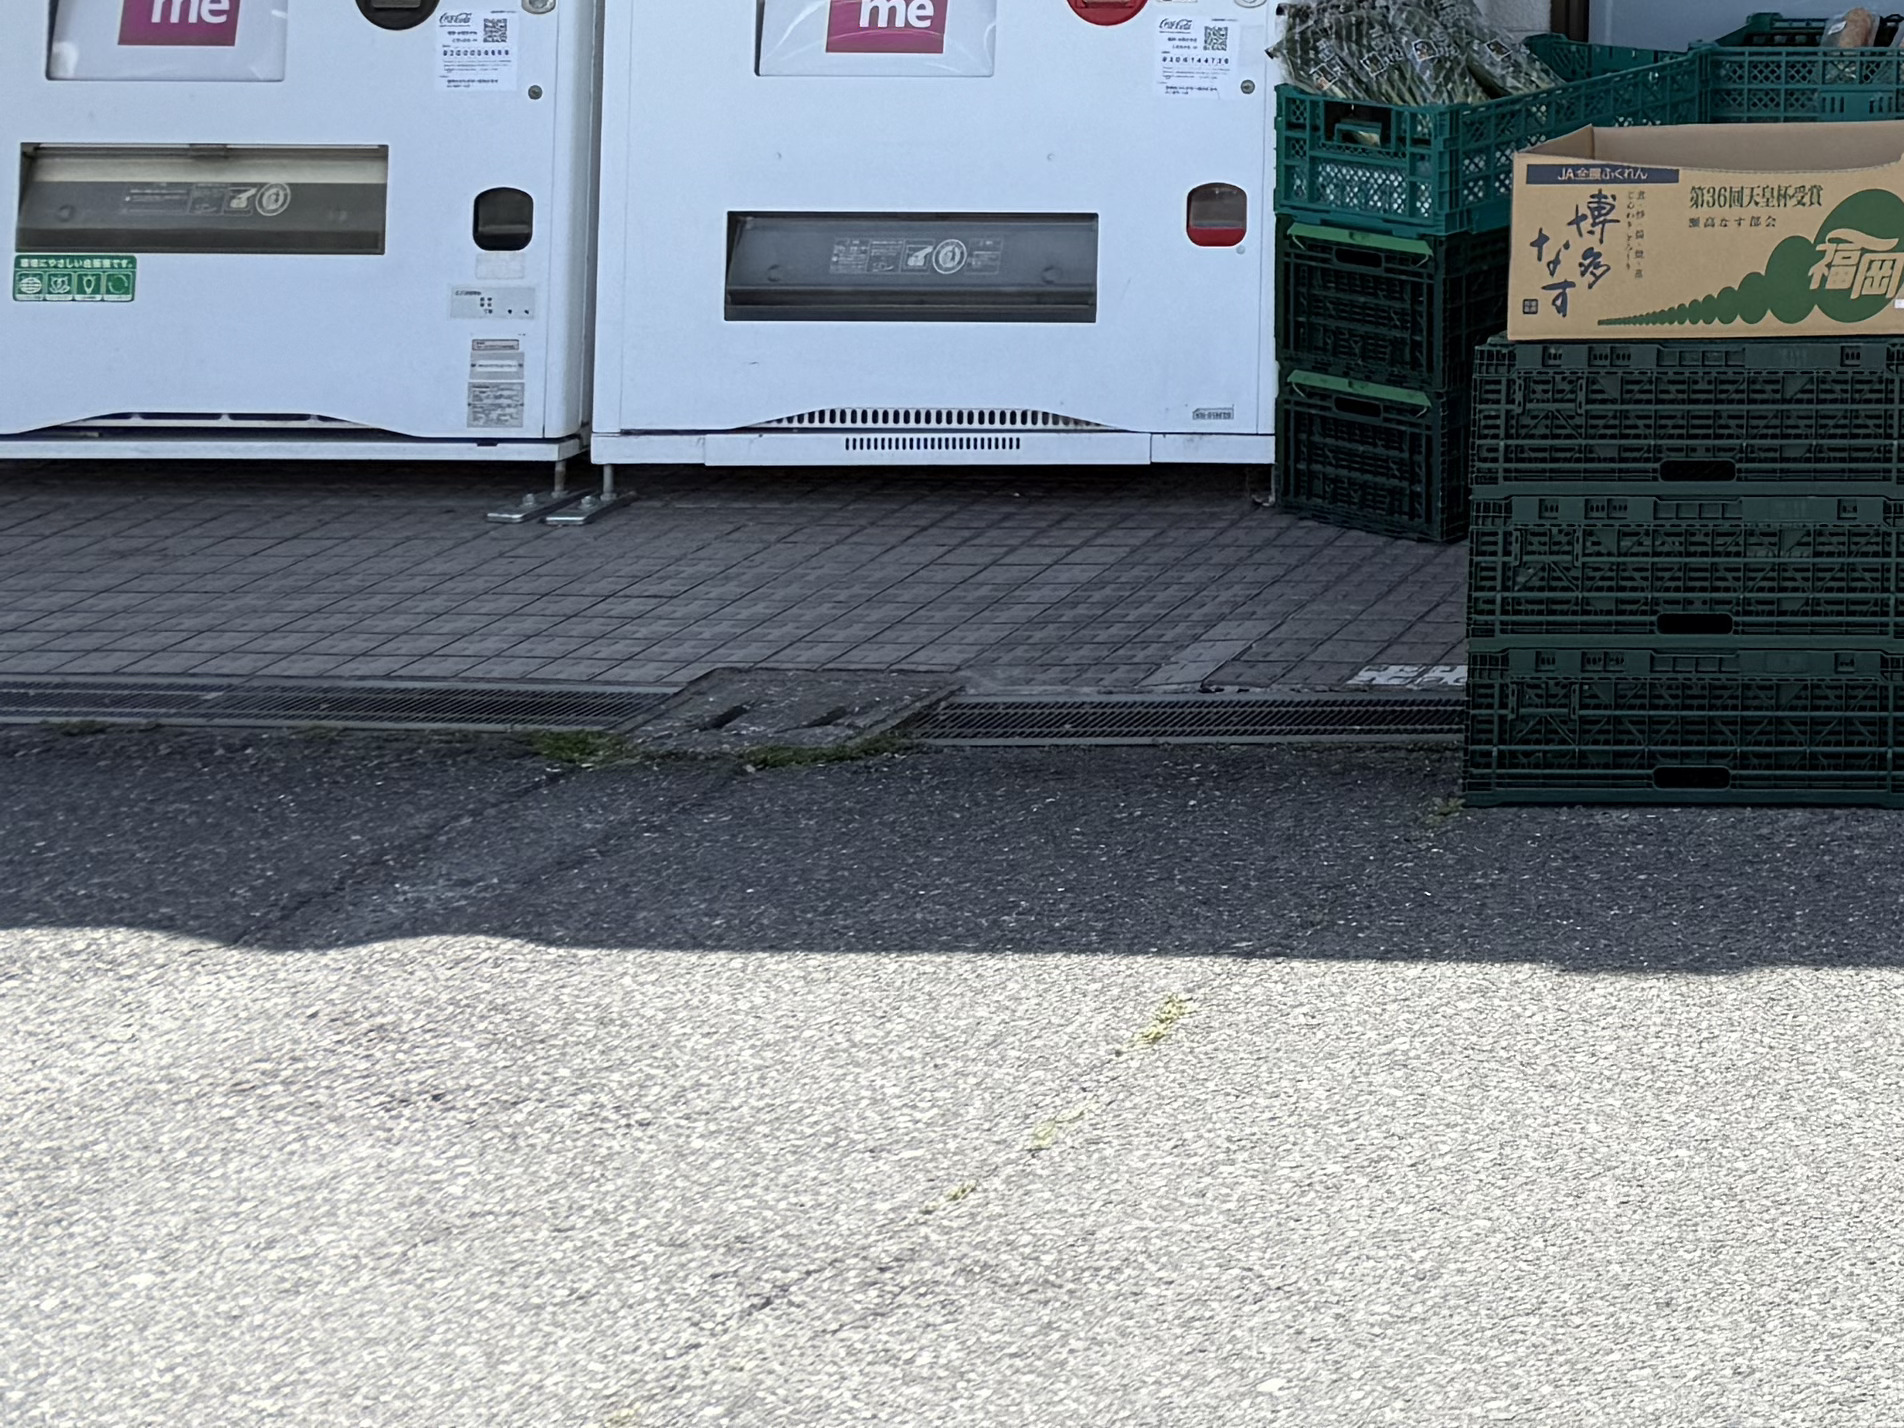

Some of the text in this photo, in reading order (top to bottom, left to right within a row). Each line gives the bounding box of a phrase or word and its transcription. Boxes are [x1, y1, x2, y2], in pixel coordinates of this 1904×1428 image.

[1689, 184, 1825, 209] 第36回天皇杯受賞
[1529, 228, 1577, 318] なす
